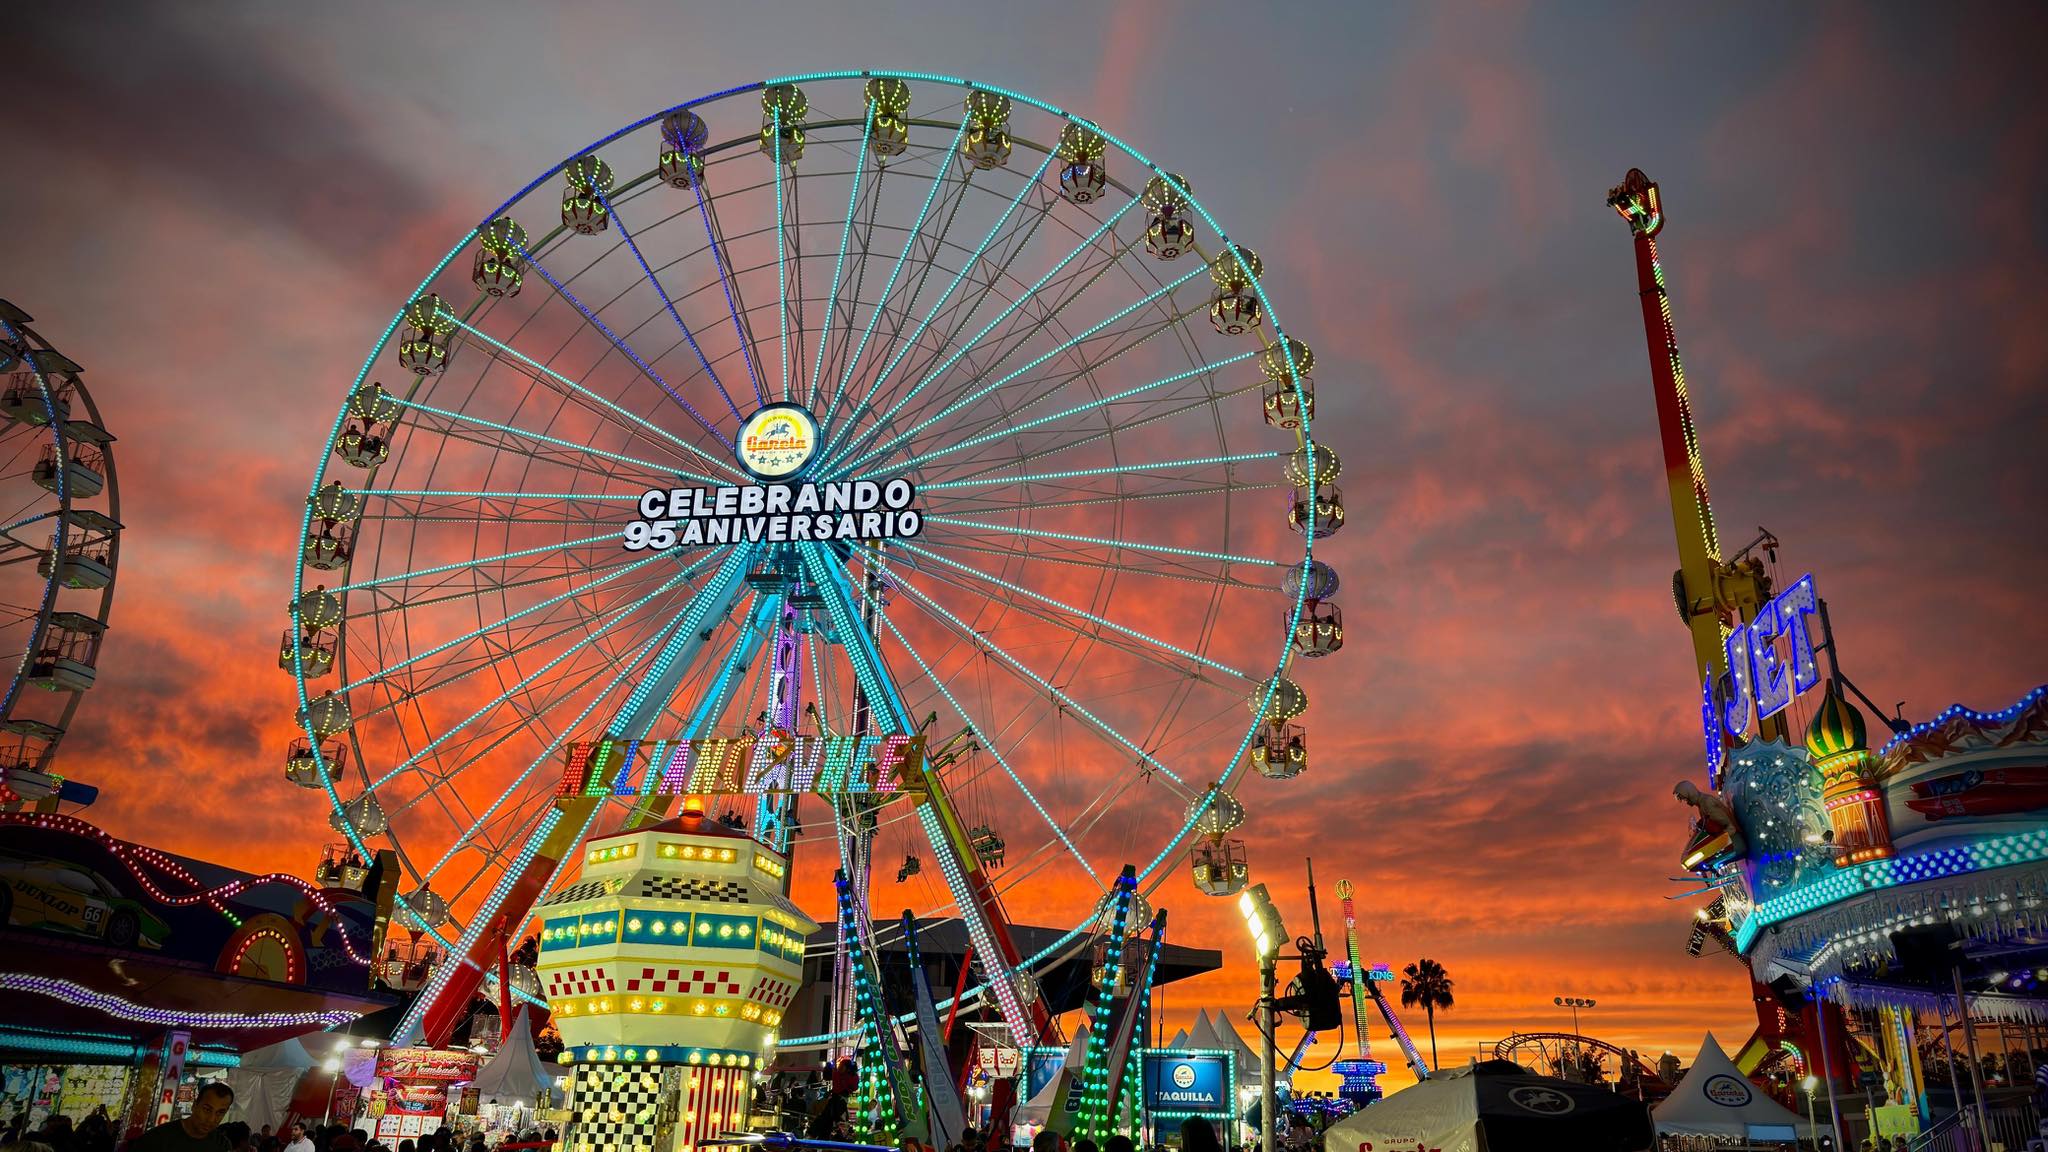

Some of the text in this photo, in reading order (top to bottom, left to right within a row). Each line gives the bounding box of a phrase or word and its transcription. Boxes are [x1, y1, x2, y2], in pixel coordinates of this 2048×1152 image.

[639, 479, 911, 519] CELEBRANDO
[623, 512, 920, 550] 95 ANIVERSARIO
[1724, 572, 1821, 736] JET
[554, 736, 780, 796] ALLIANCE
[15, 881, 101, 922] DUNLOP 66
[1369, 970, 1394, 981] KING
[892, 1066, 917, 1121] KIDS
[1156, 1091, 1215, 1103] TAQUILLA
